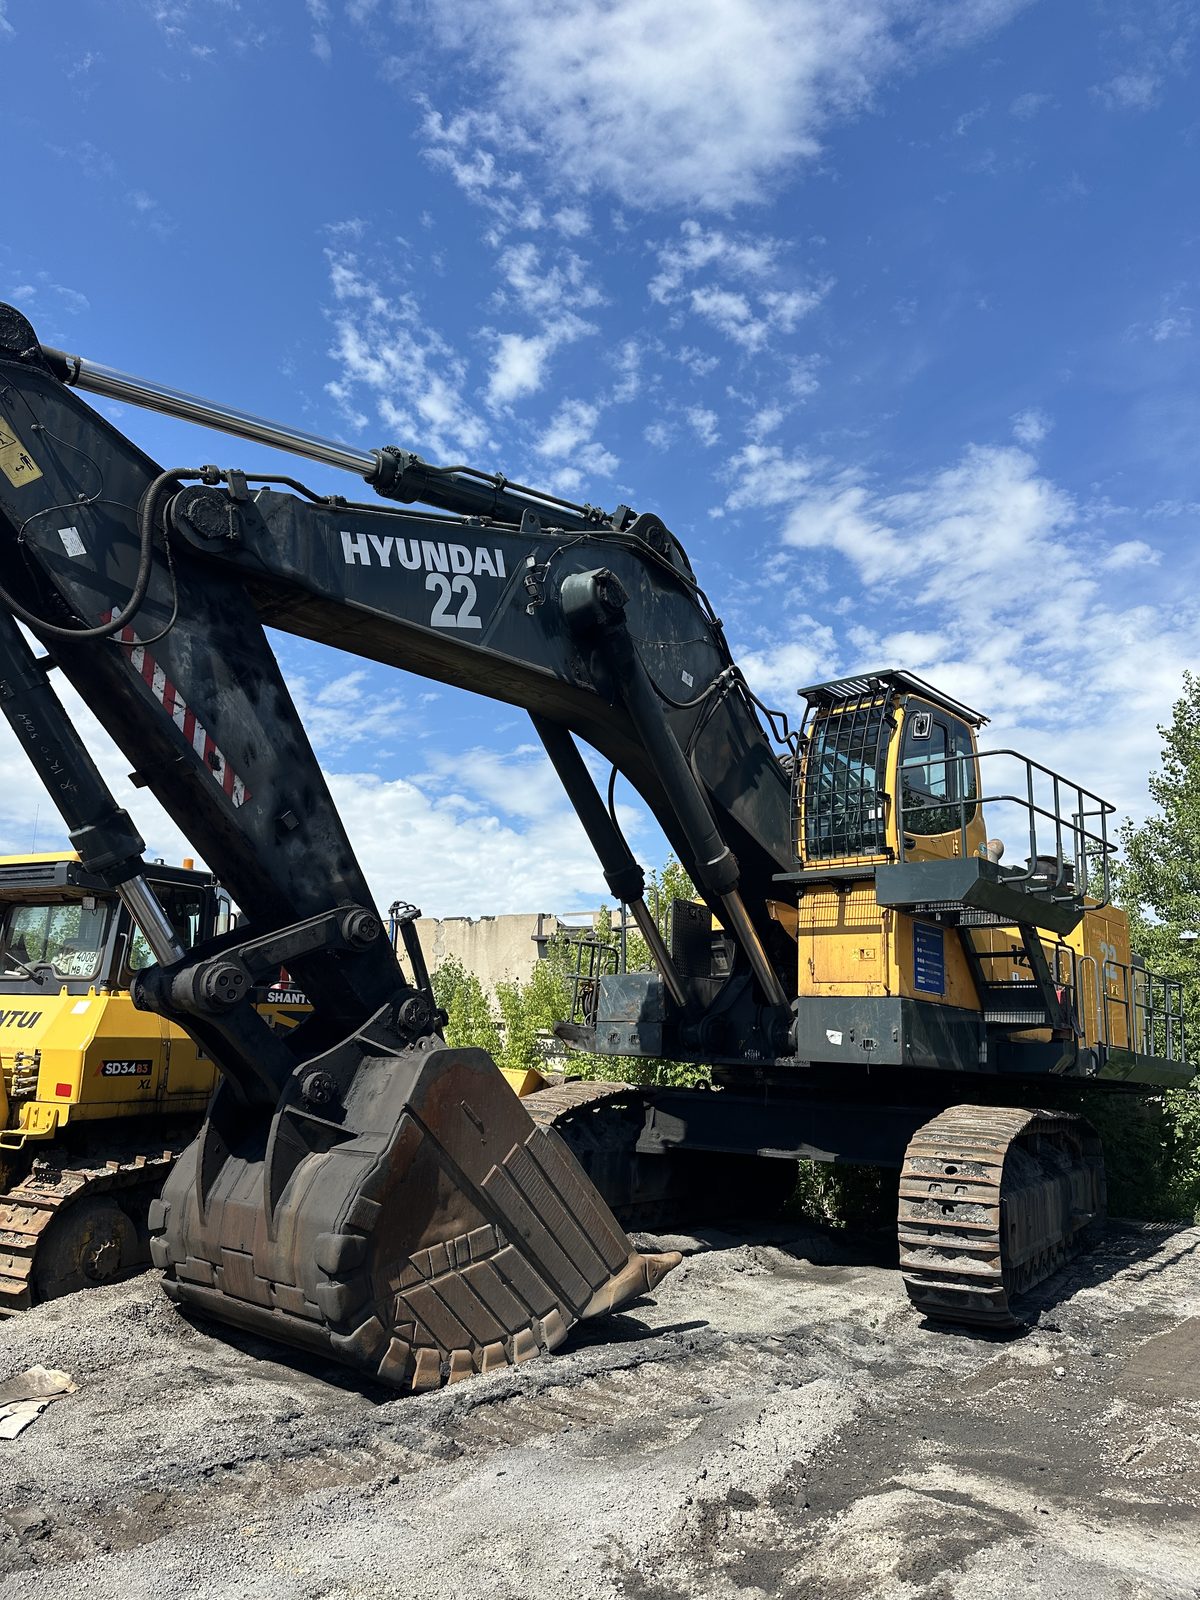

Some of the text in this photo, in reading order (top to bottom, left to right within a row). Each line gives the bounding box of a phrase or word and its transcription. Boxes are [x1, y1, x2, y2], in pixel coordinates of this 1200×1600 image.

[340, 531, 506, 577] HYUNDAI
[425, 573, 482, 628] 22
[77, 952, 96, 962] 4008
[267, 992, 311, 1004] SHANT
[137, 1079, 151, 1090] XL
